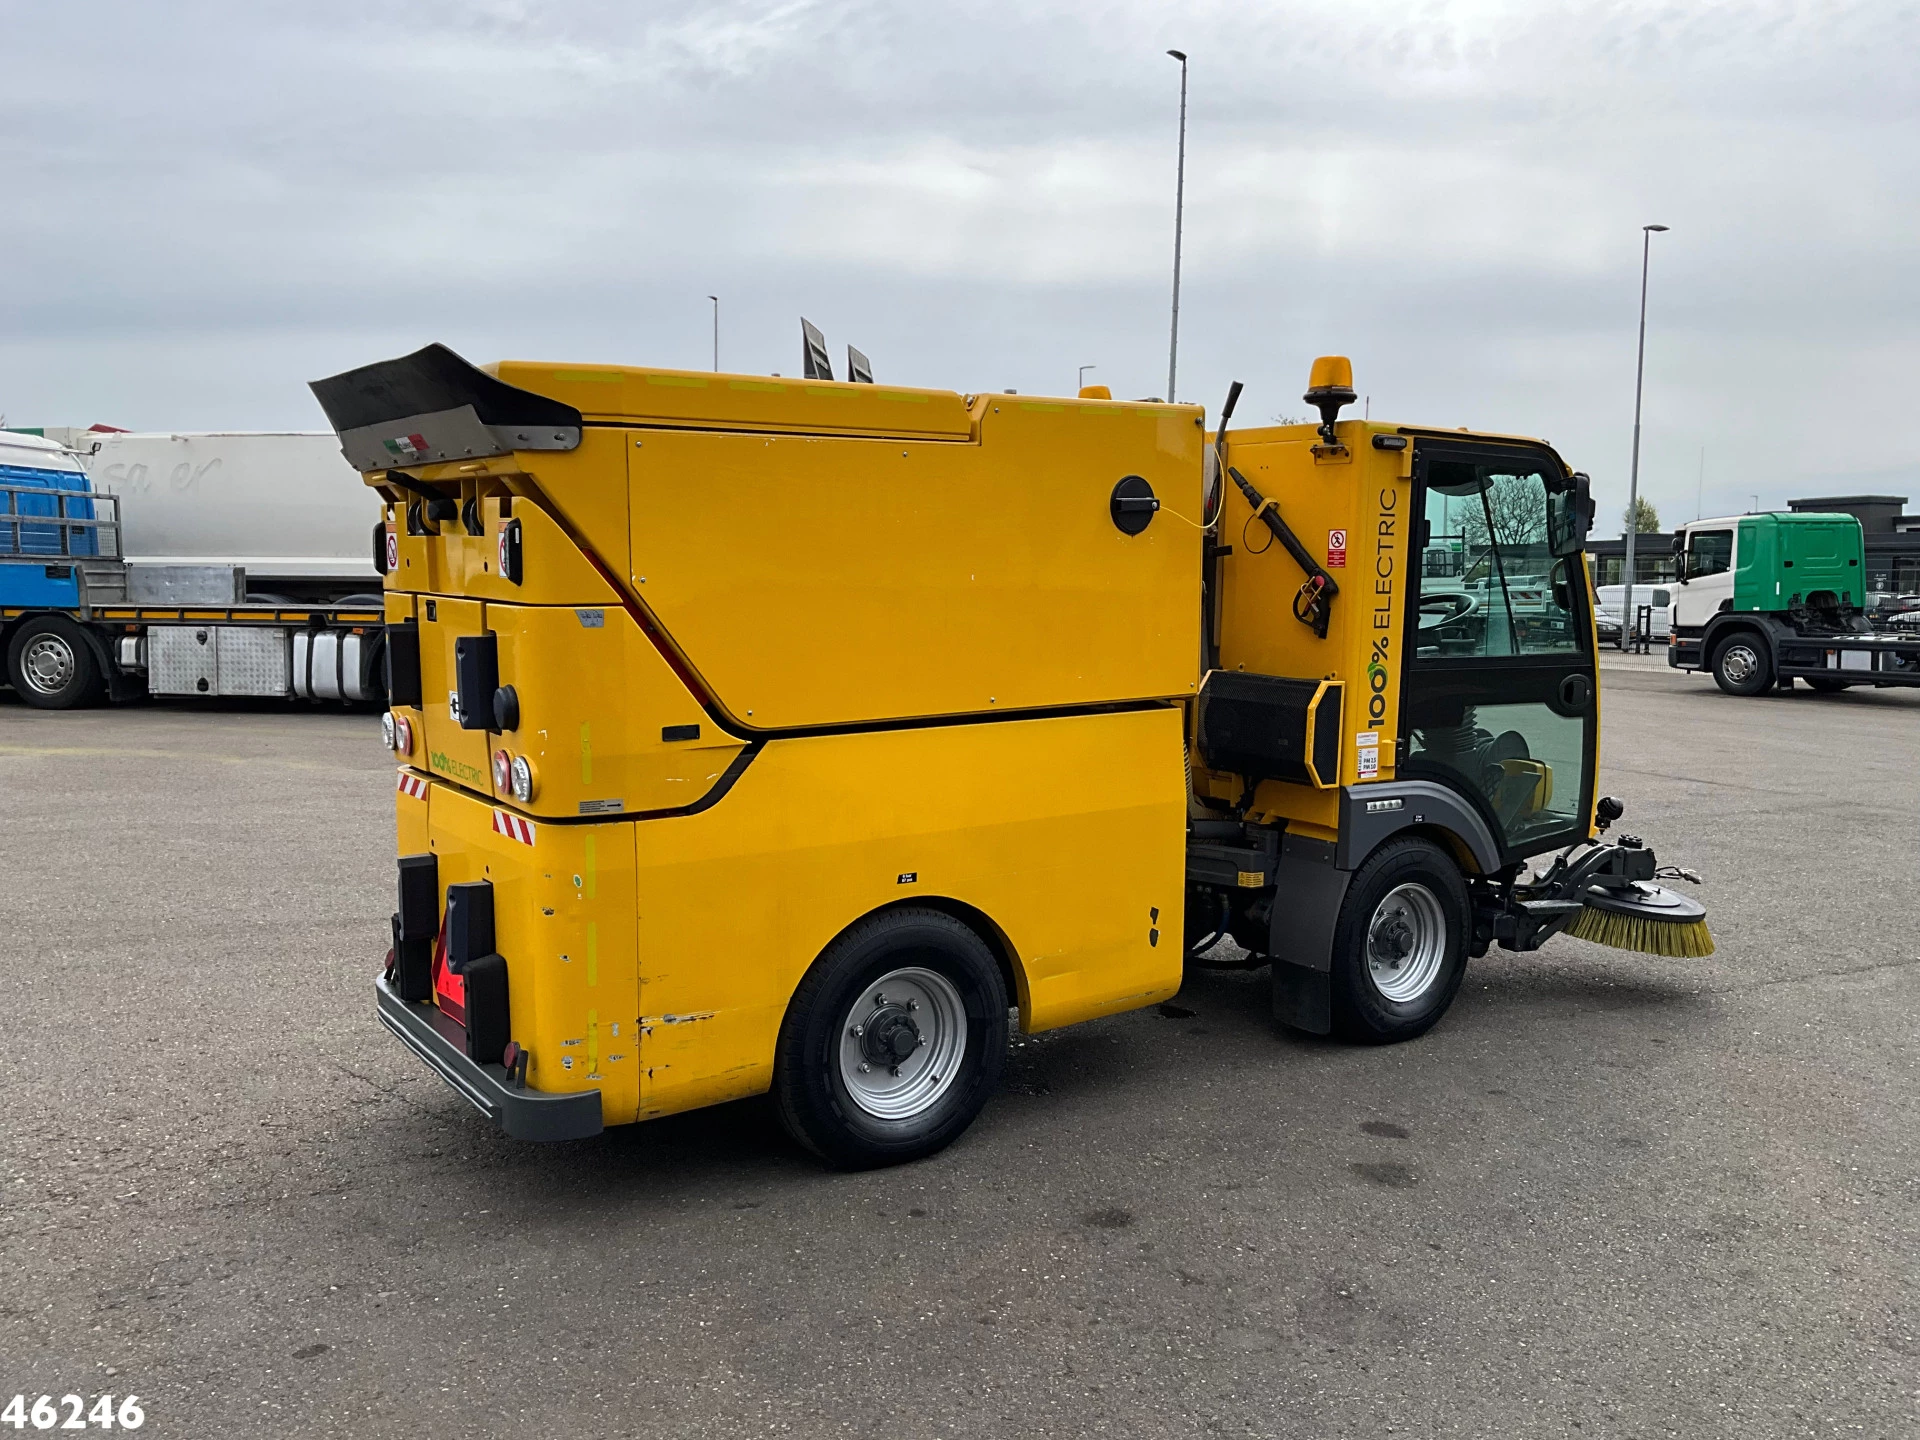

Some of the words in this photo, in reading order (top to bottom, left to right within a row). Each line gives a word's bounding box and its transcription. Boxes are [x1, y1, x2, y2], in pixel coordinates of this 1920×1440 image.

[1374, 488, 1396, 629] ELECTRIC
[1368, 636, 1389, 729] 100%
[451, 759, 484, 786] ELECTRIC
